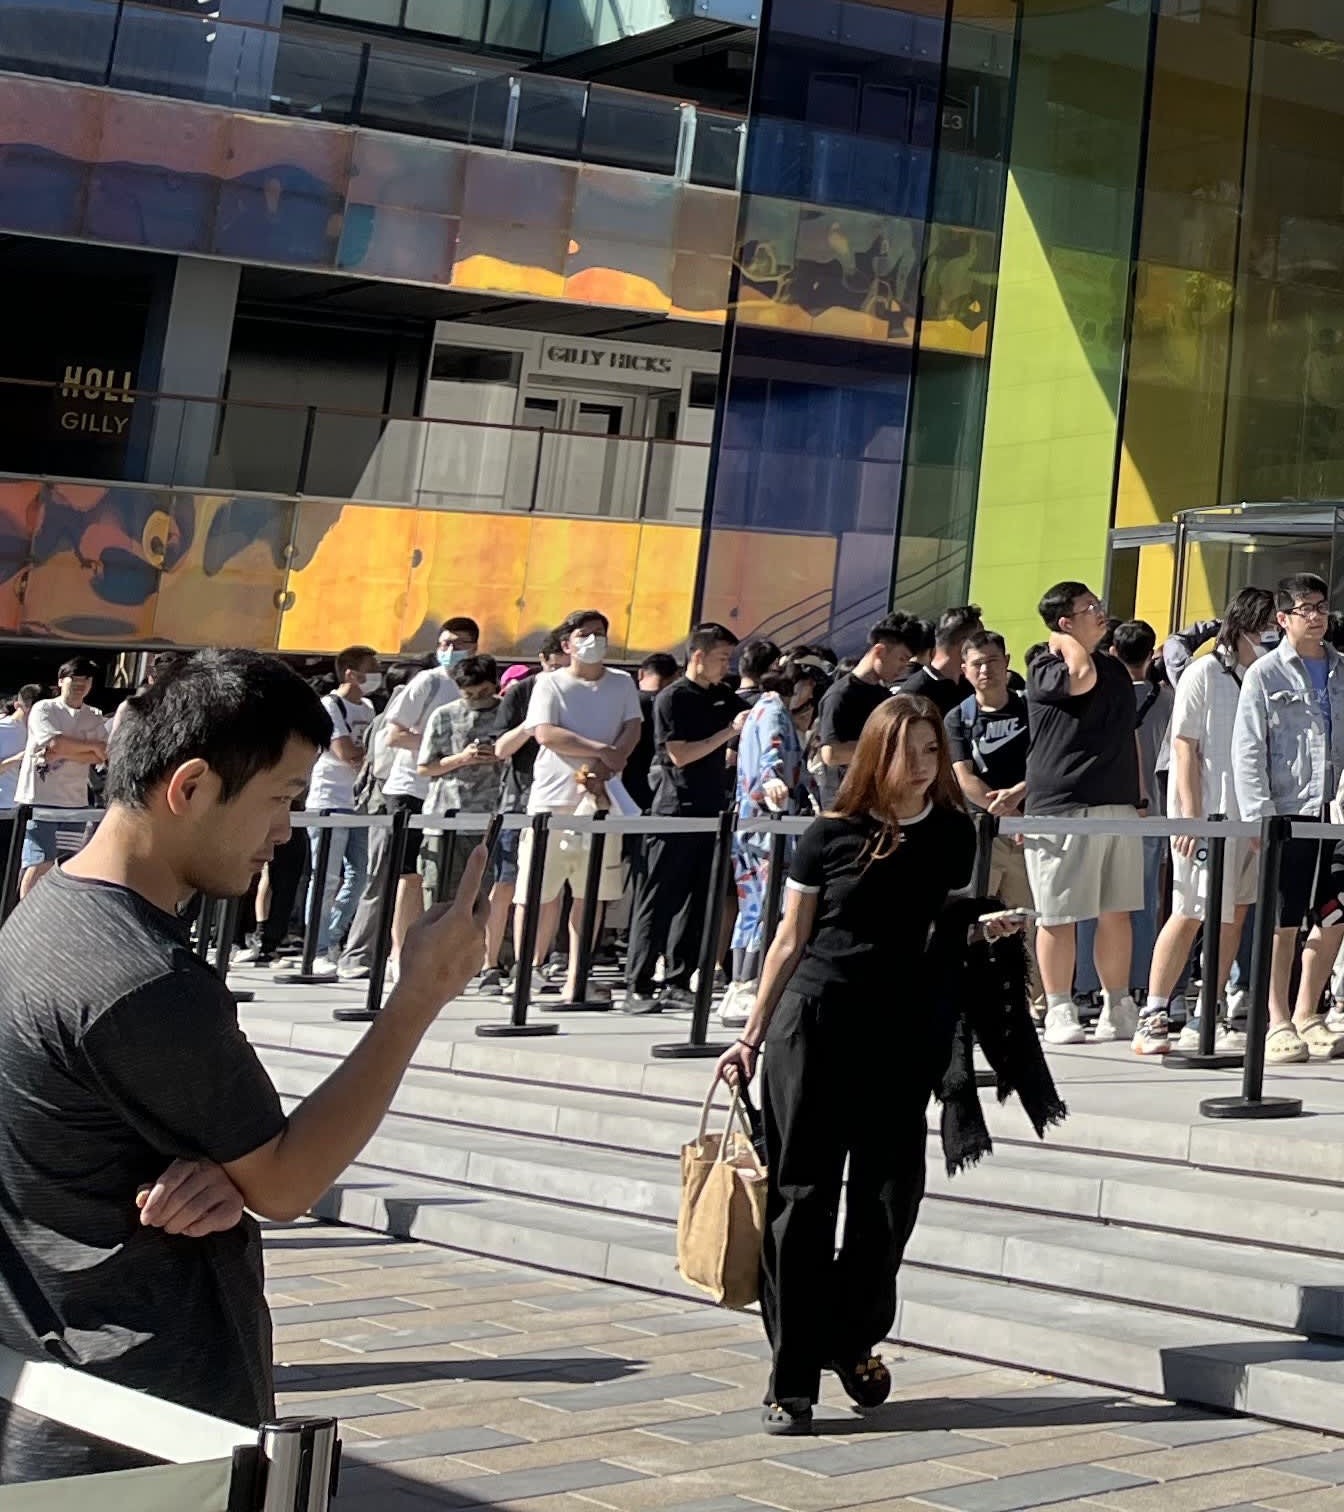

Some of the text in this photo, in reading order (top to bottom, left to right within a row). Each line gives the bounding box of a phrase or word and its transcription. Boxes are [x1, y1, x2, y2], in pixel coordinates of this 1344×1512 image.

[548, 345, 672, 373] GILLY HICKS
[61, 365, 136, 403] HOLL
[61, 411, 128, 434] GILLY
[986, 717, 1019, 739] NIKE
